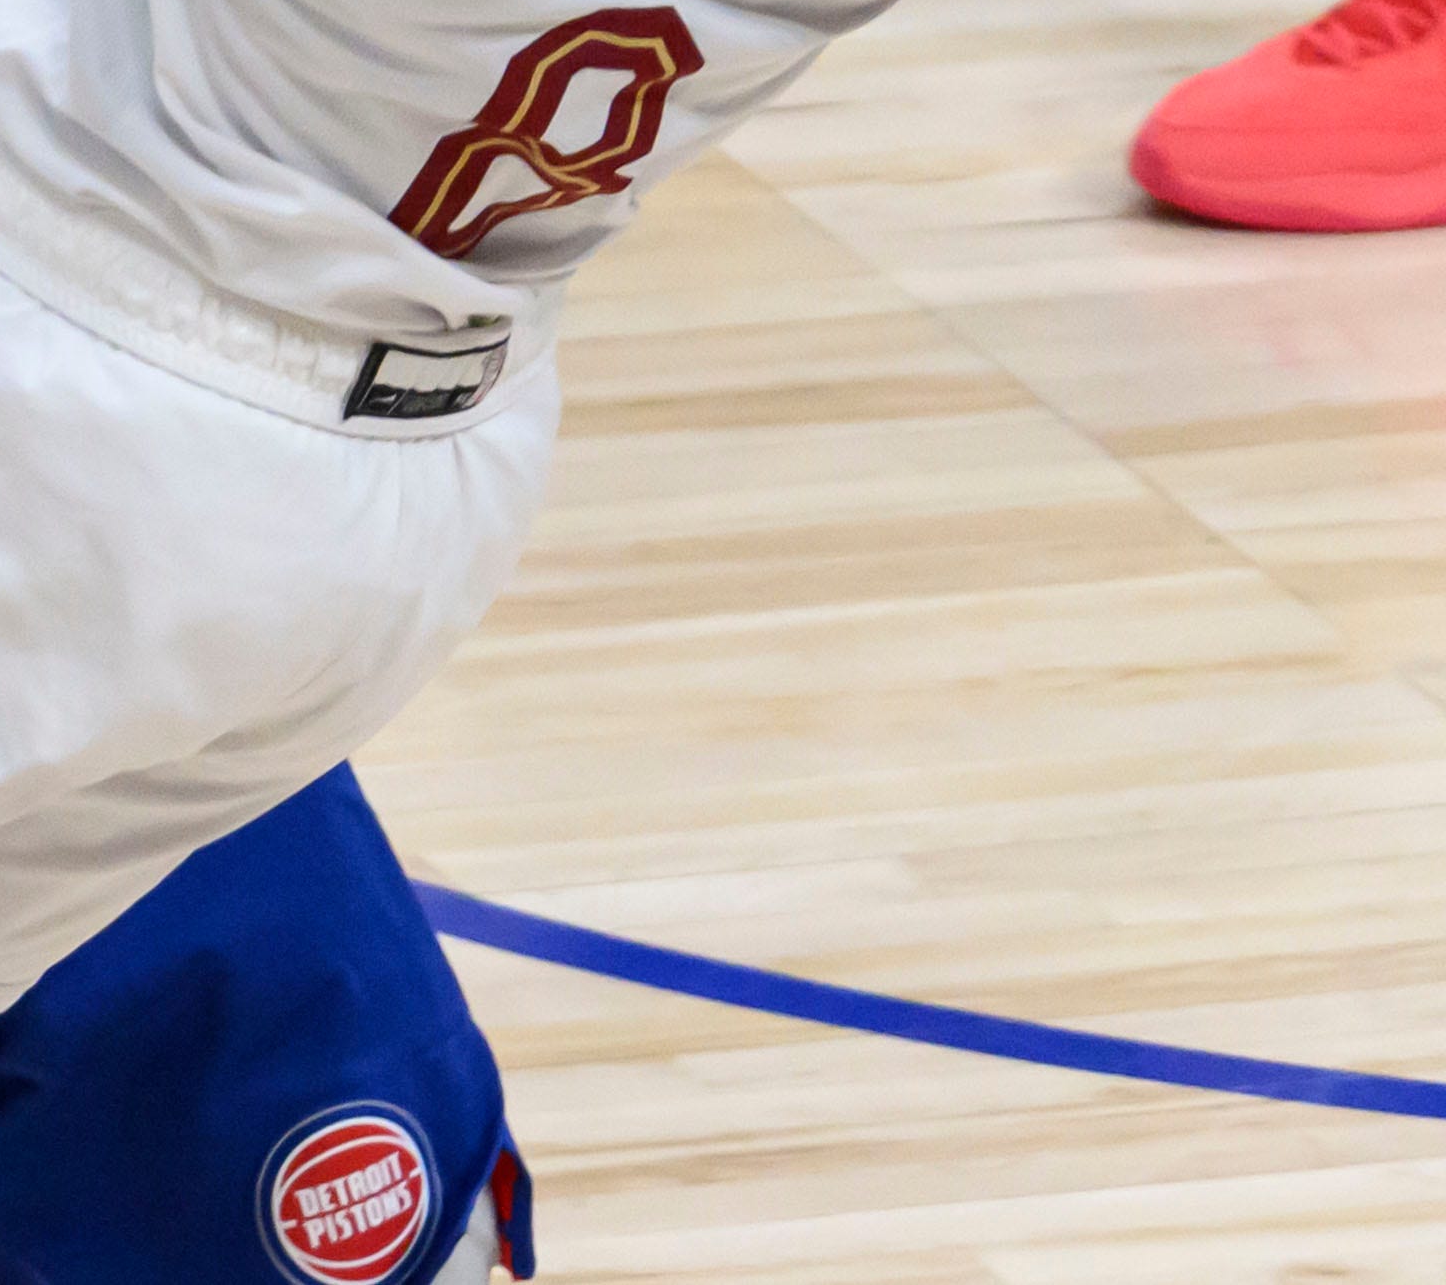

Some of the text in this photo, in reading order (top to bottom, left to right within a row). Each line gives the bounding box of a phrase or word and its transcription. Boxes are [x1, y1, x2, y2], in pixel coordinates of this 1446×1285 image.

[388, 6, 704, 259] 8
[295, 1152, 403, 1216] DETROIT
[303, 1182, 412, 1248] PISTONS
